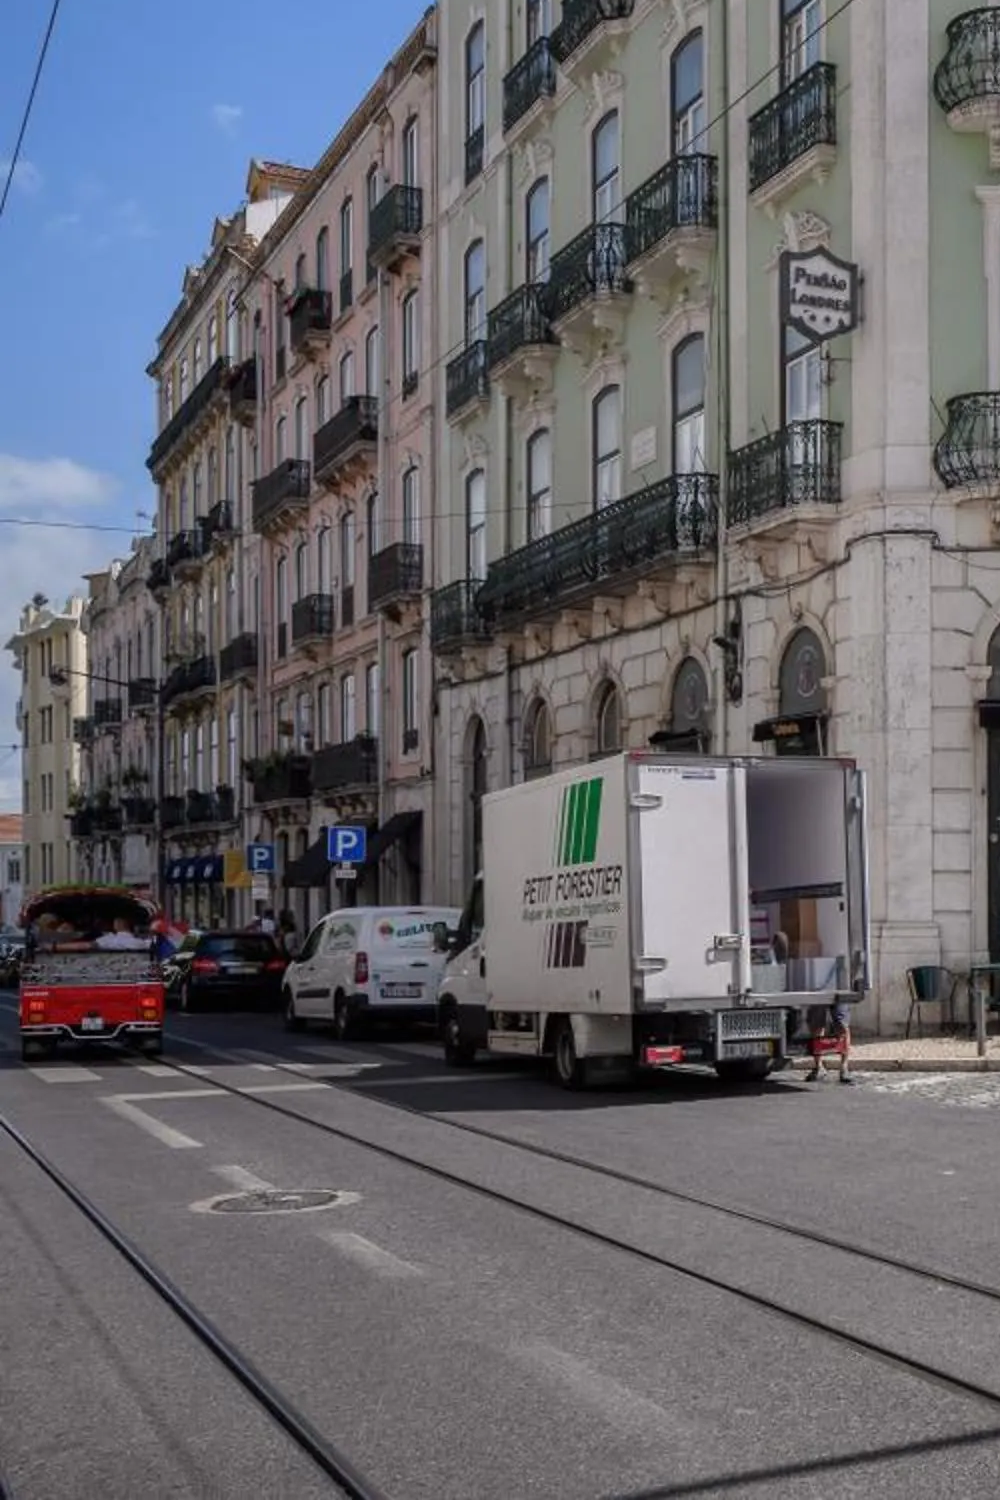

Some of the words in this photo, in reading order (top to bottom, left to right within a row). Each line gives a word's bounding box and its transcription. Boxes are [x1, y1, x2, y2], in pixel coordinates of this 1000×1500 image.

[253, 847, 270, 869] P
[336, 830, 358, 858] P
[523, 876, 553, 904] PETIT
[555, 865, 622, 901] FORESTIER
